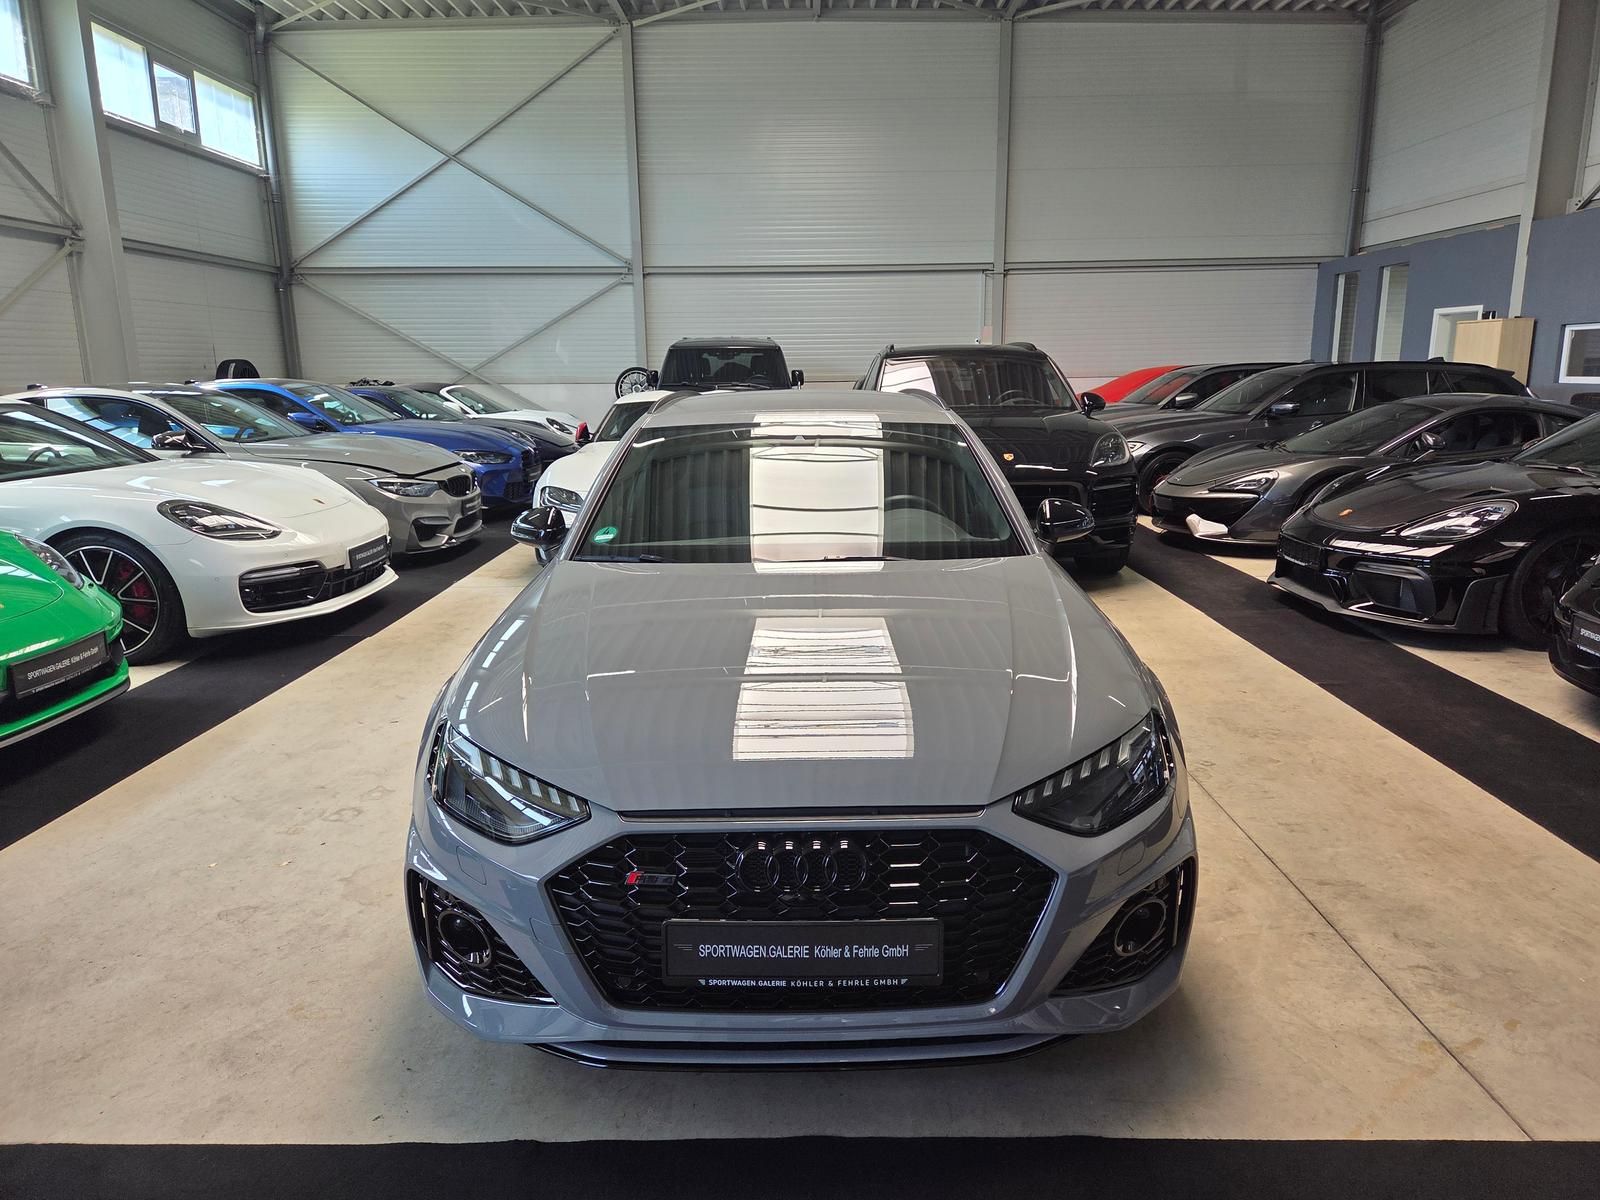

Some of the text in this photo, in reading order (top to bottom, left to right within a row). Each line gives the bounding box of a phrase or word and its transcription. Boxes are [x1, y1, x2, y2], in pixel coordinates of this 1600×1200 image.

[814, 945, 842, 958] Köhler
[843, 945, 851, 958] &
[852, 945, 880, 958] Fehrle
[881, 944, 909, 958] GmbH
[790, 979, 825, 988] KÖHLER
[828, 979, 834, 987] &
[837, 979, 870, 987] FEHRLE
[873, 978, 898, 986] GMBH
